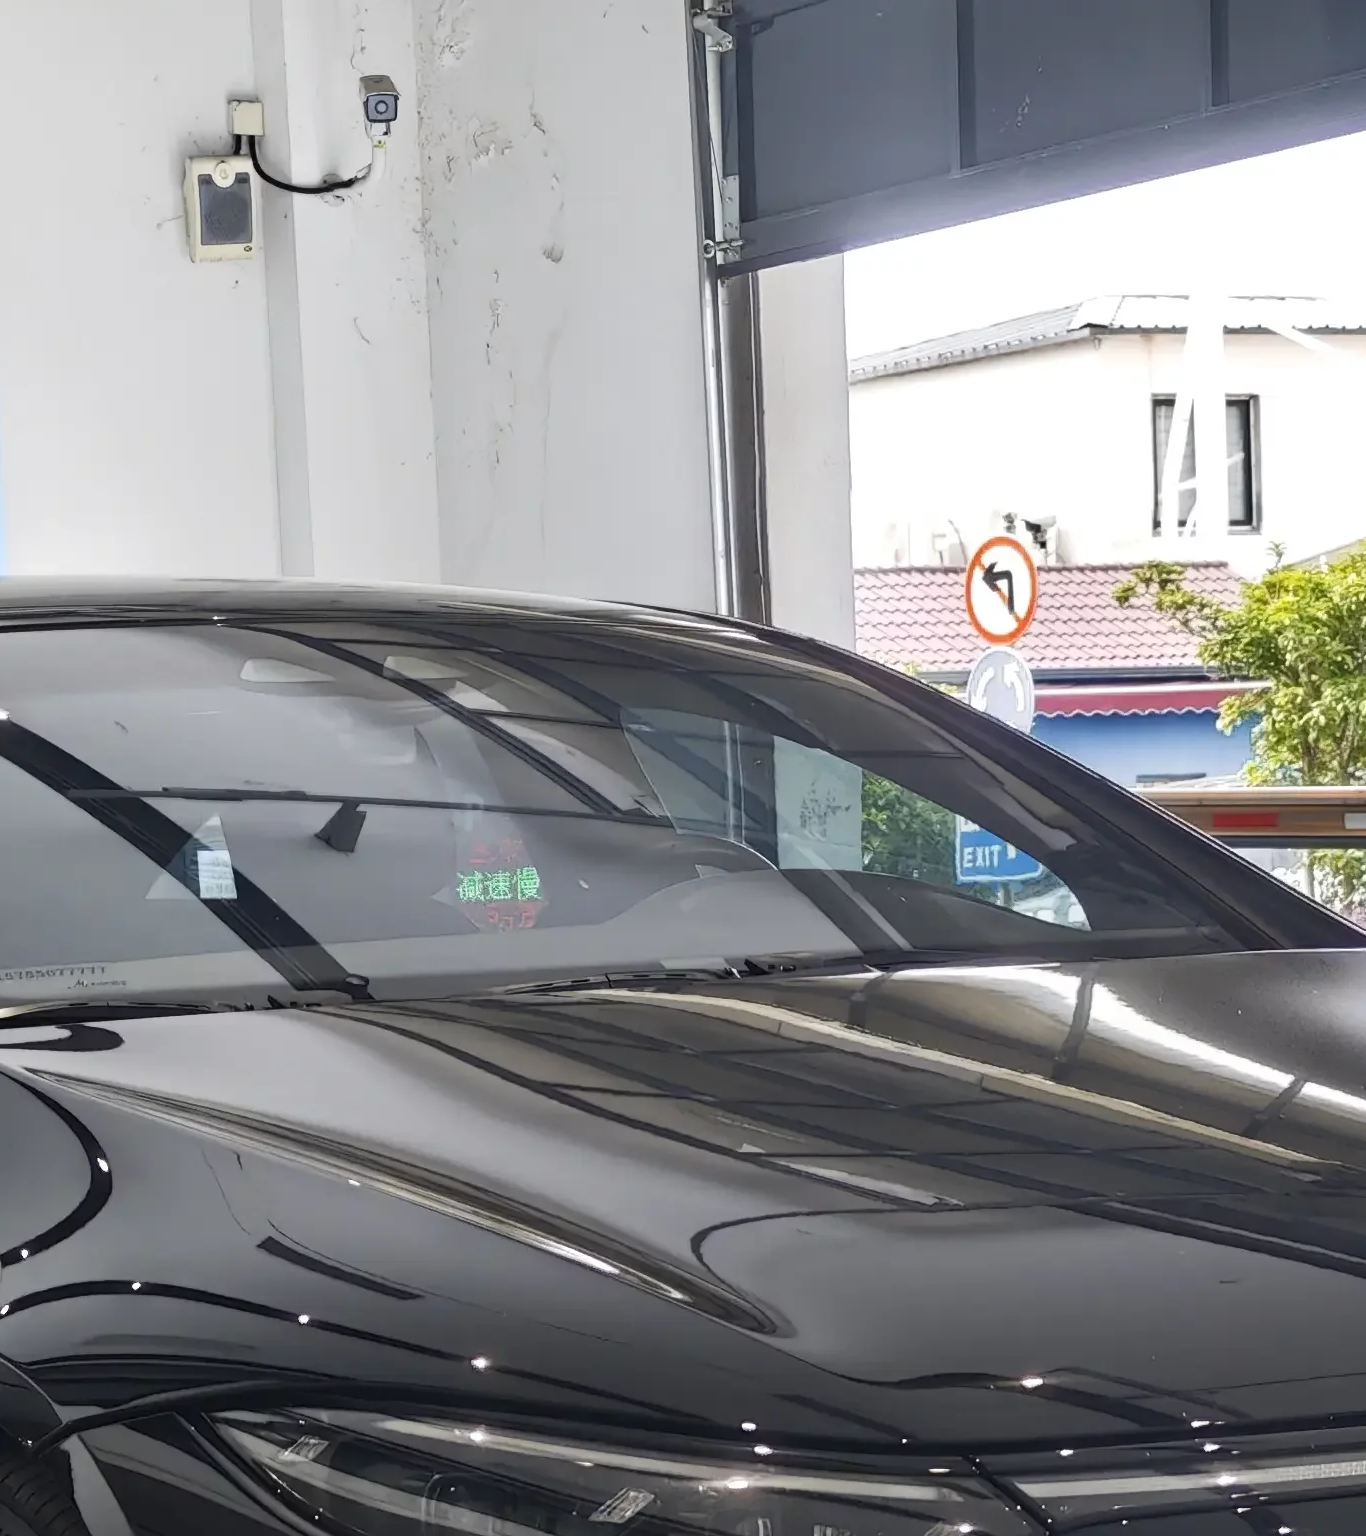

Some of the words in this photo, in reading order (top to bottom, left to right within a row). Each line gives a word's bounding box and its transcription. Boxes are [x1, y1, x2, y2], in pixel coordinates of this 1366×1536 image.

[962, 844, 1003, 869] EXIT
[456, 866, 543, 903] 减速慢
